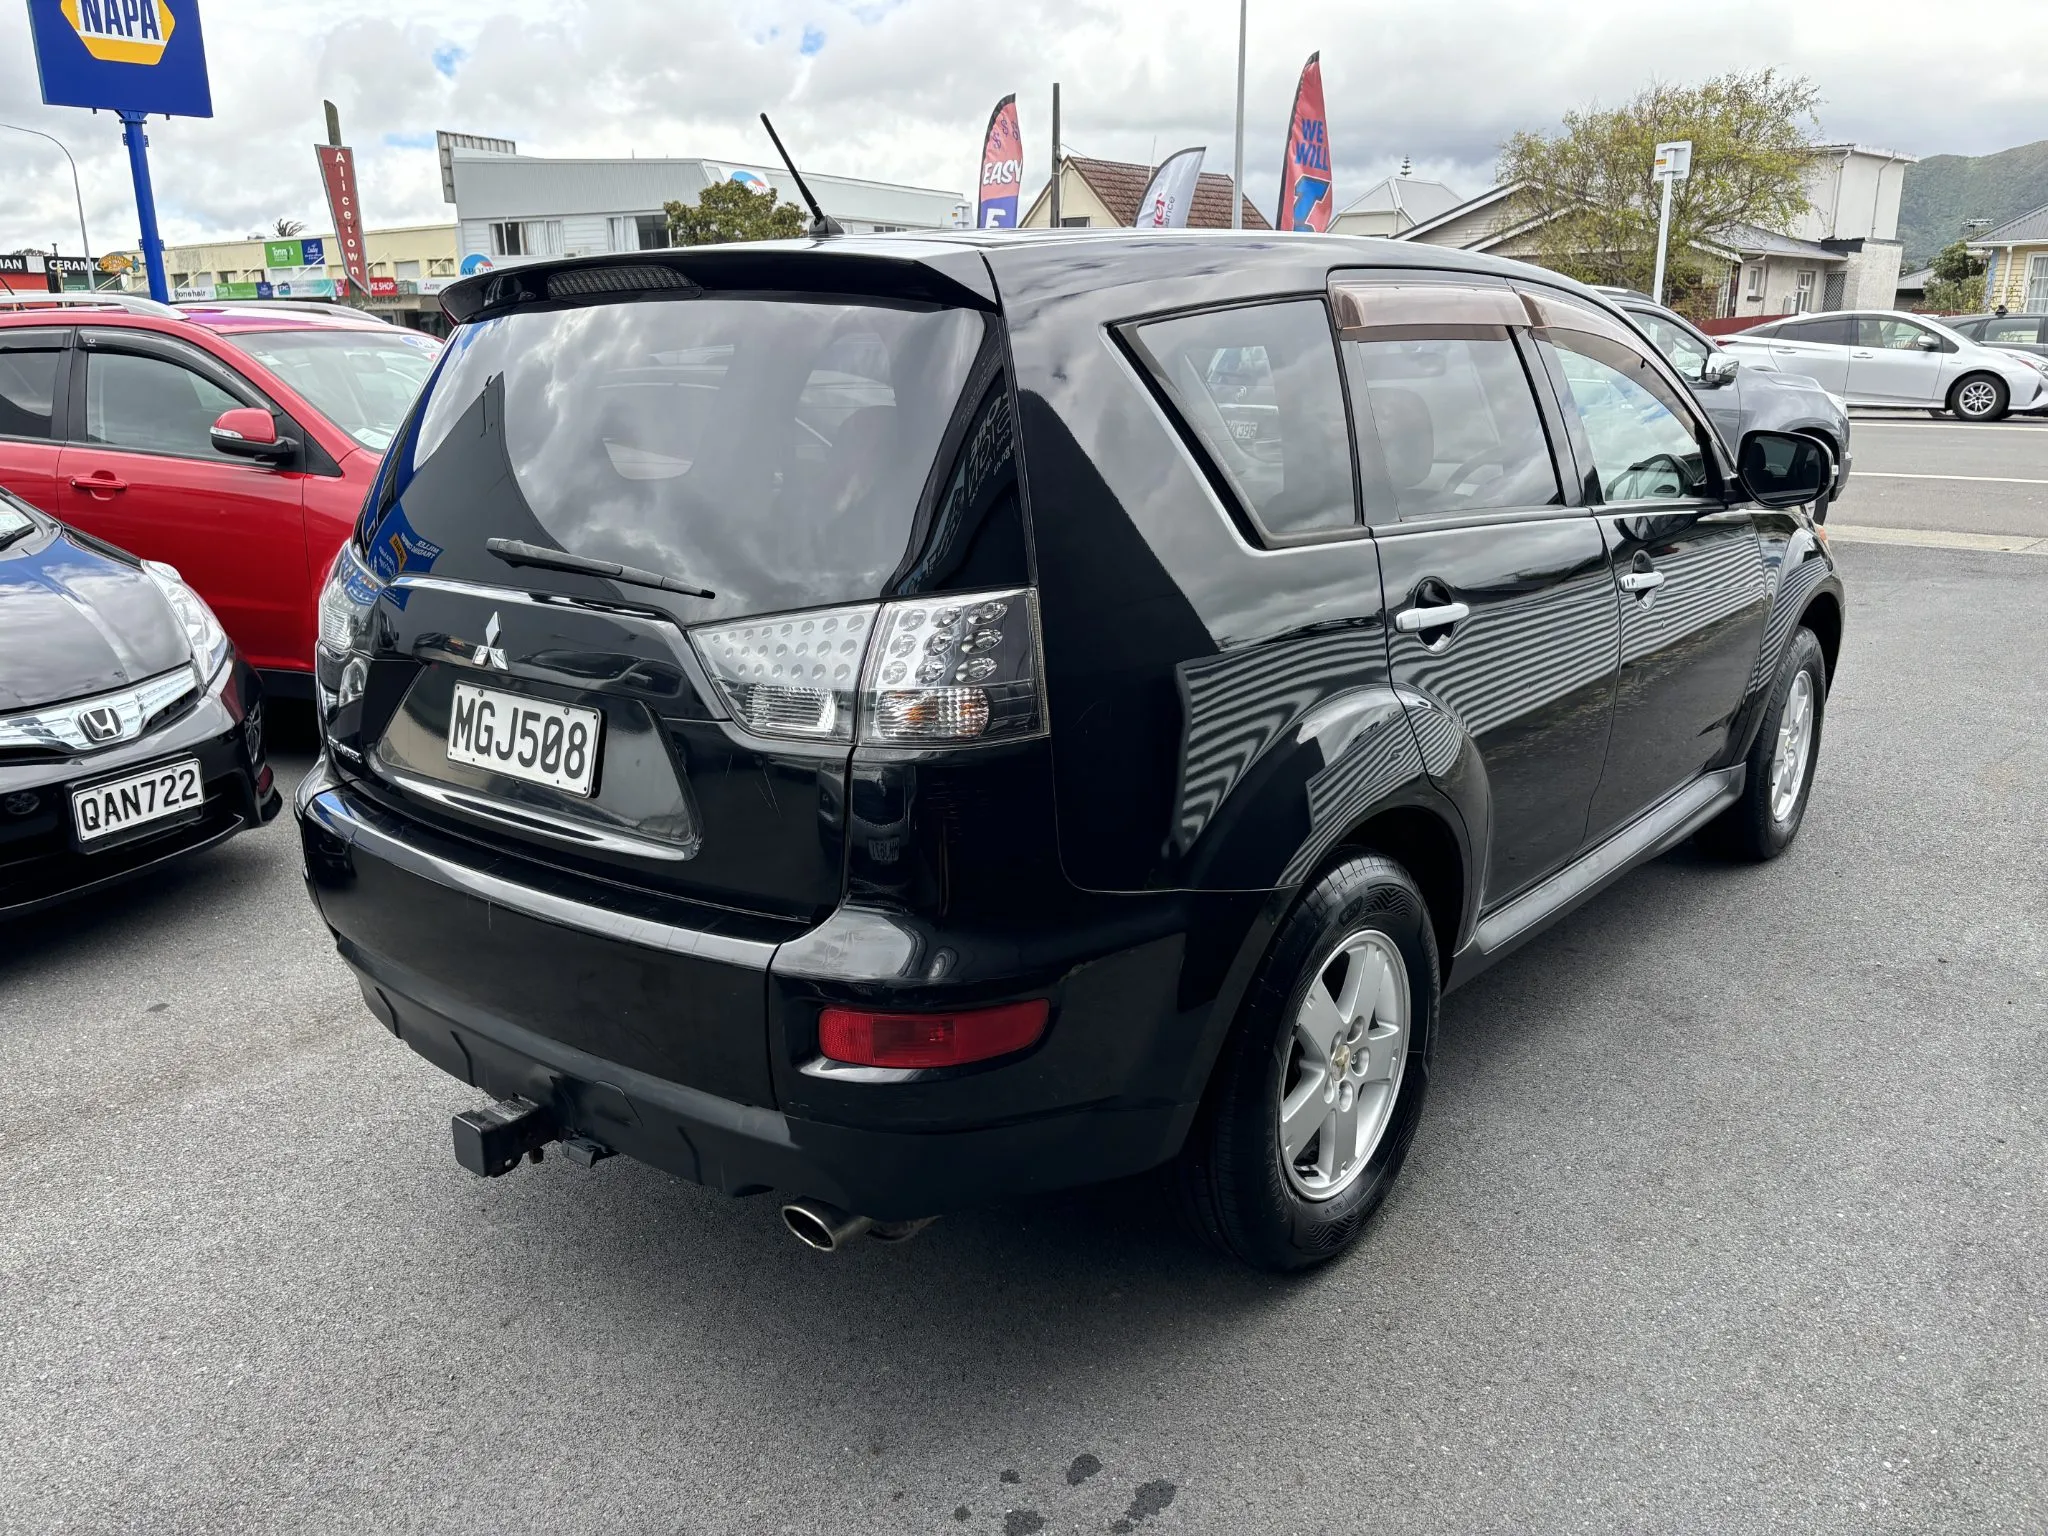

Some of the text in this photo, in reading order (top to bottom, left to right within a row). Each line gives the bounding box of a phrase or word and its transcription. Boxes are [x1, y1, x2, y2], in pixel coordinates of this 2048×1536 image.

[80, 0, 160, 40] NAPA
[1302, 118, 1323, 143] WE
[1295, 143, 1328, 171] WILL
[983, 160, 1022, 185] EASY
[335, 151, 360, 275] Alicetown
[0, 259, 23, 270] AN
[380, 282, 394, 290] SHOP
[453, 695, 587, 779] MGJ508
[81, 769, 198, 831] QAN722
